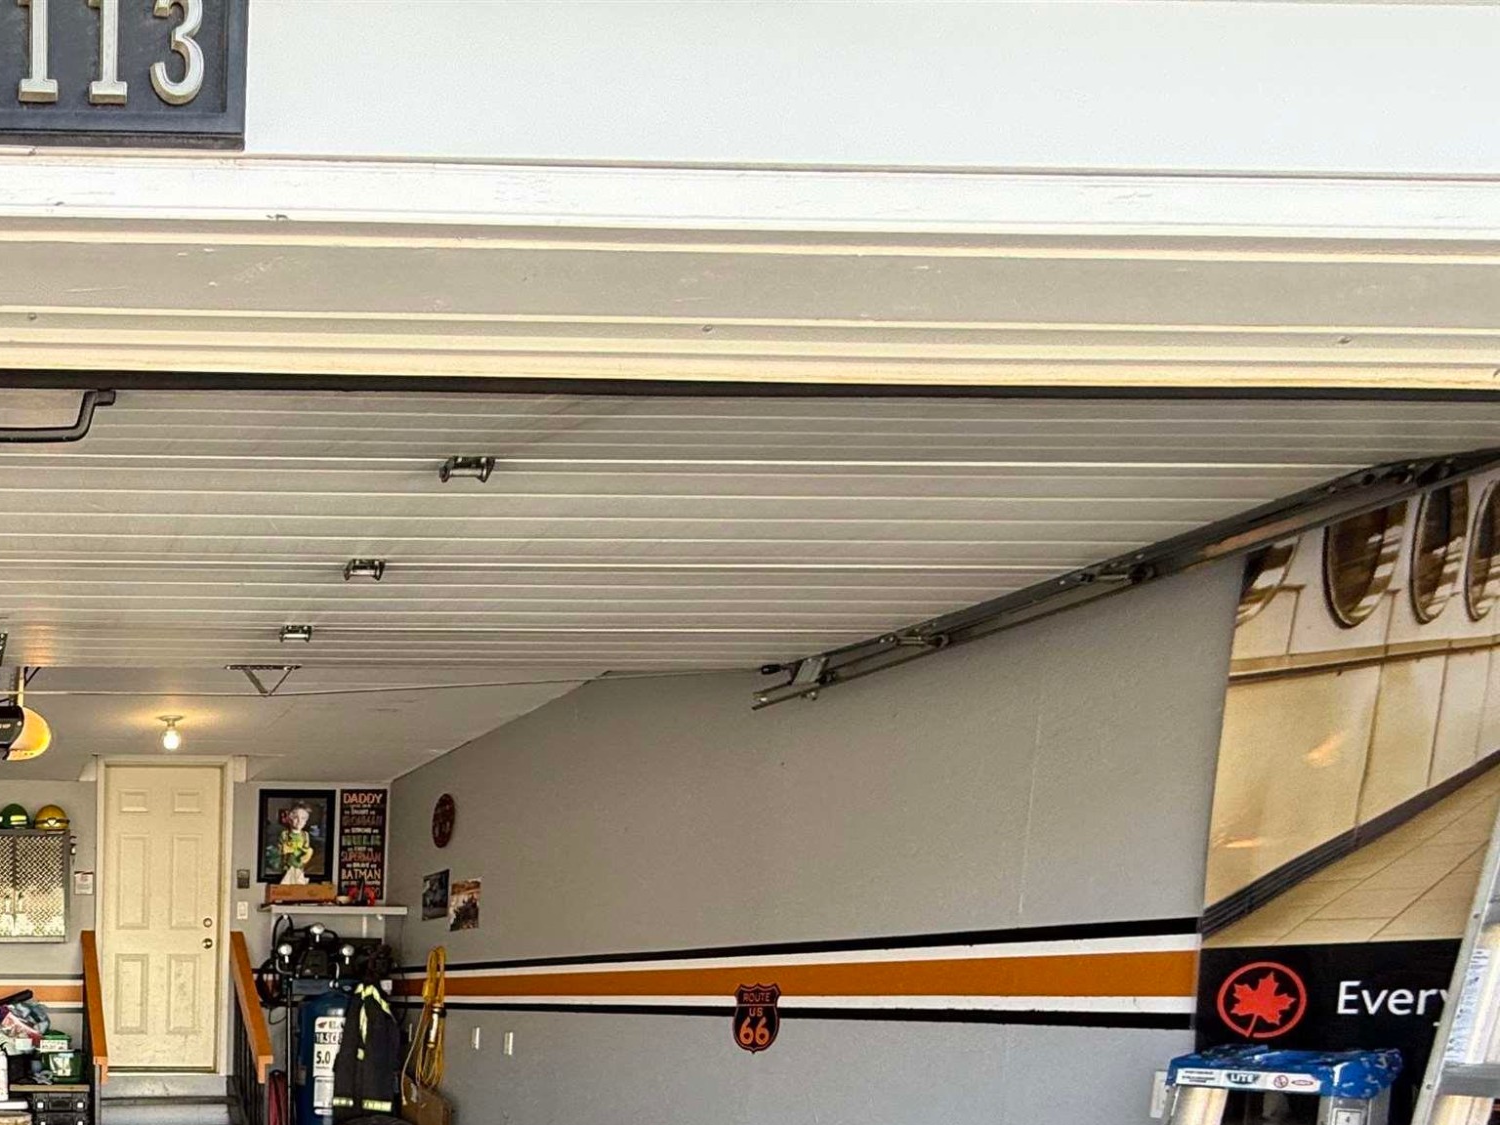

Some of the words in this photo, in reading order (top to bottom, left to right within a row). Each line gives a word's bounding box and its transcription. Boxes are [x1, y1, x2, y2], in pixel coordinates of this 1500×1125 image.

[343, 793, 382, 804] DADDY
[341, 868, 381, 880] BATMAN
[742, 992, 771, 1002] ROUTE
[749, 1007, 764, 1017] US
[739, 1016, 770, 1045] 66
[316, 1051, 331, 1064] 5.0
[1230, 1072, 1255, 1083] LITE
